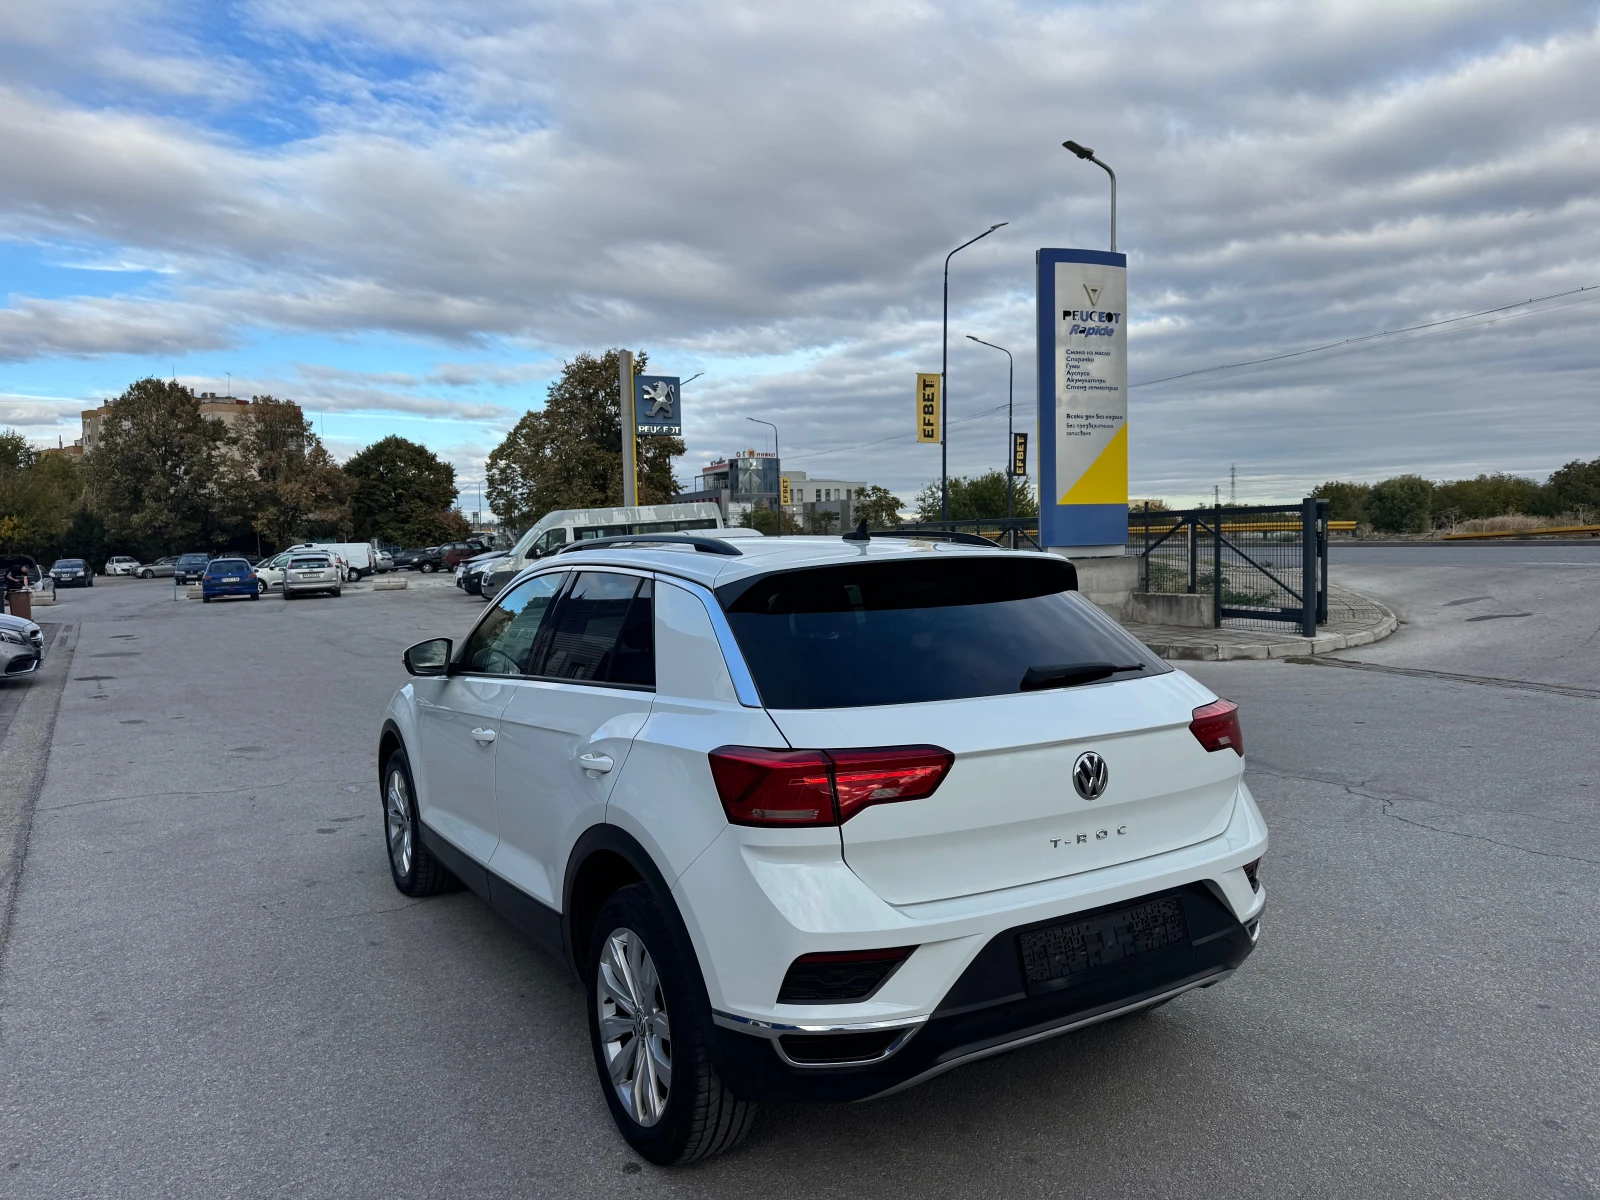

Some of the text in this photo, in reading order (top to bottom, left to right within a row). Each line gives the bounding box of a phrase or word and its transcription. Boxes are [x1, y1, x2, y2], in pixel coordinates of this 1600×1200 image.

[1062, 310, 1121, 324] PEUGEOT
[1069, 323, 1115, 338] Rapide
[923, 378, 935, 438] EFBET
[1016, 435, 1025, 474] EFBET
[1050, 824, 1127, 849] T-ROC
